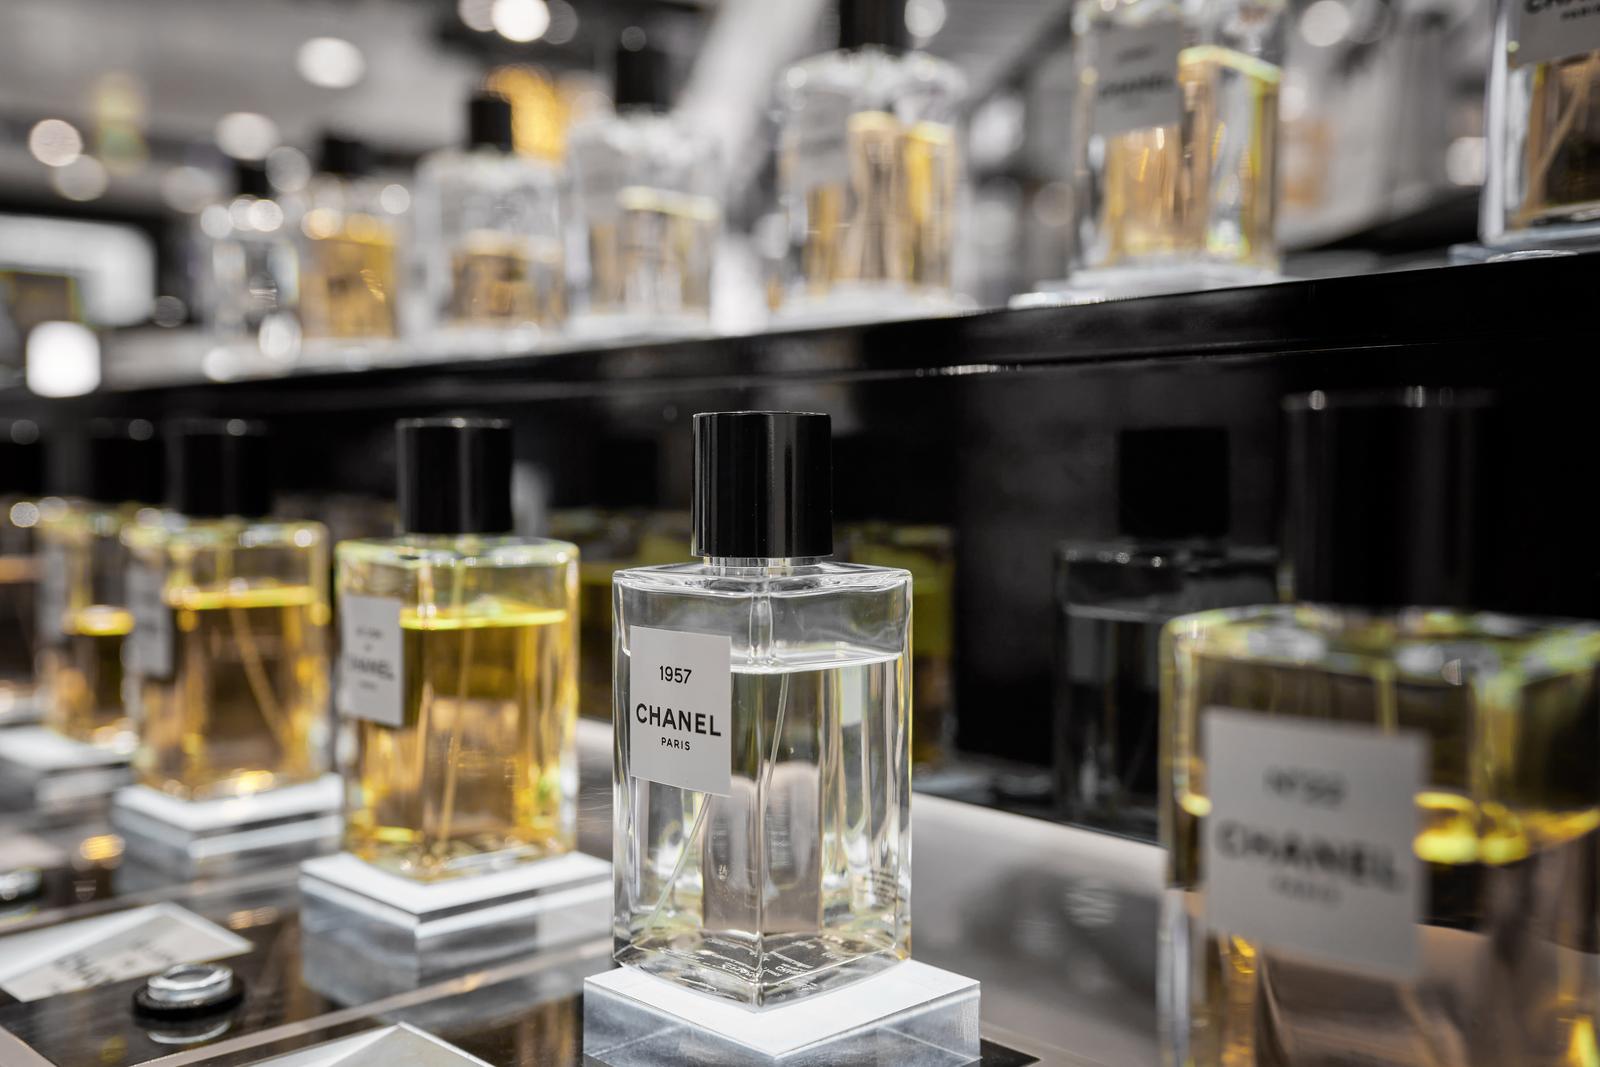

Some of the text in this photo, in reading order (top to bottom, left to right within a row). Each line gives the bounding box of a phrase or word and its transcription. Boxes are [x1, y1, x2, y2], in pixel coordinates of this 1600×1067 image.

[659, 665, 692, 683] 1957
[636, 703, 721, 736] CHANEL
[661, 737, 691, 751] PARIS
